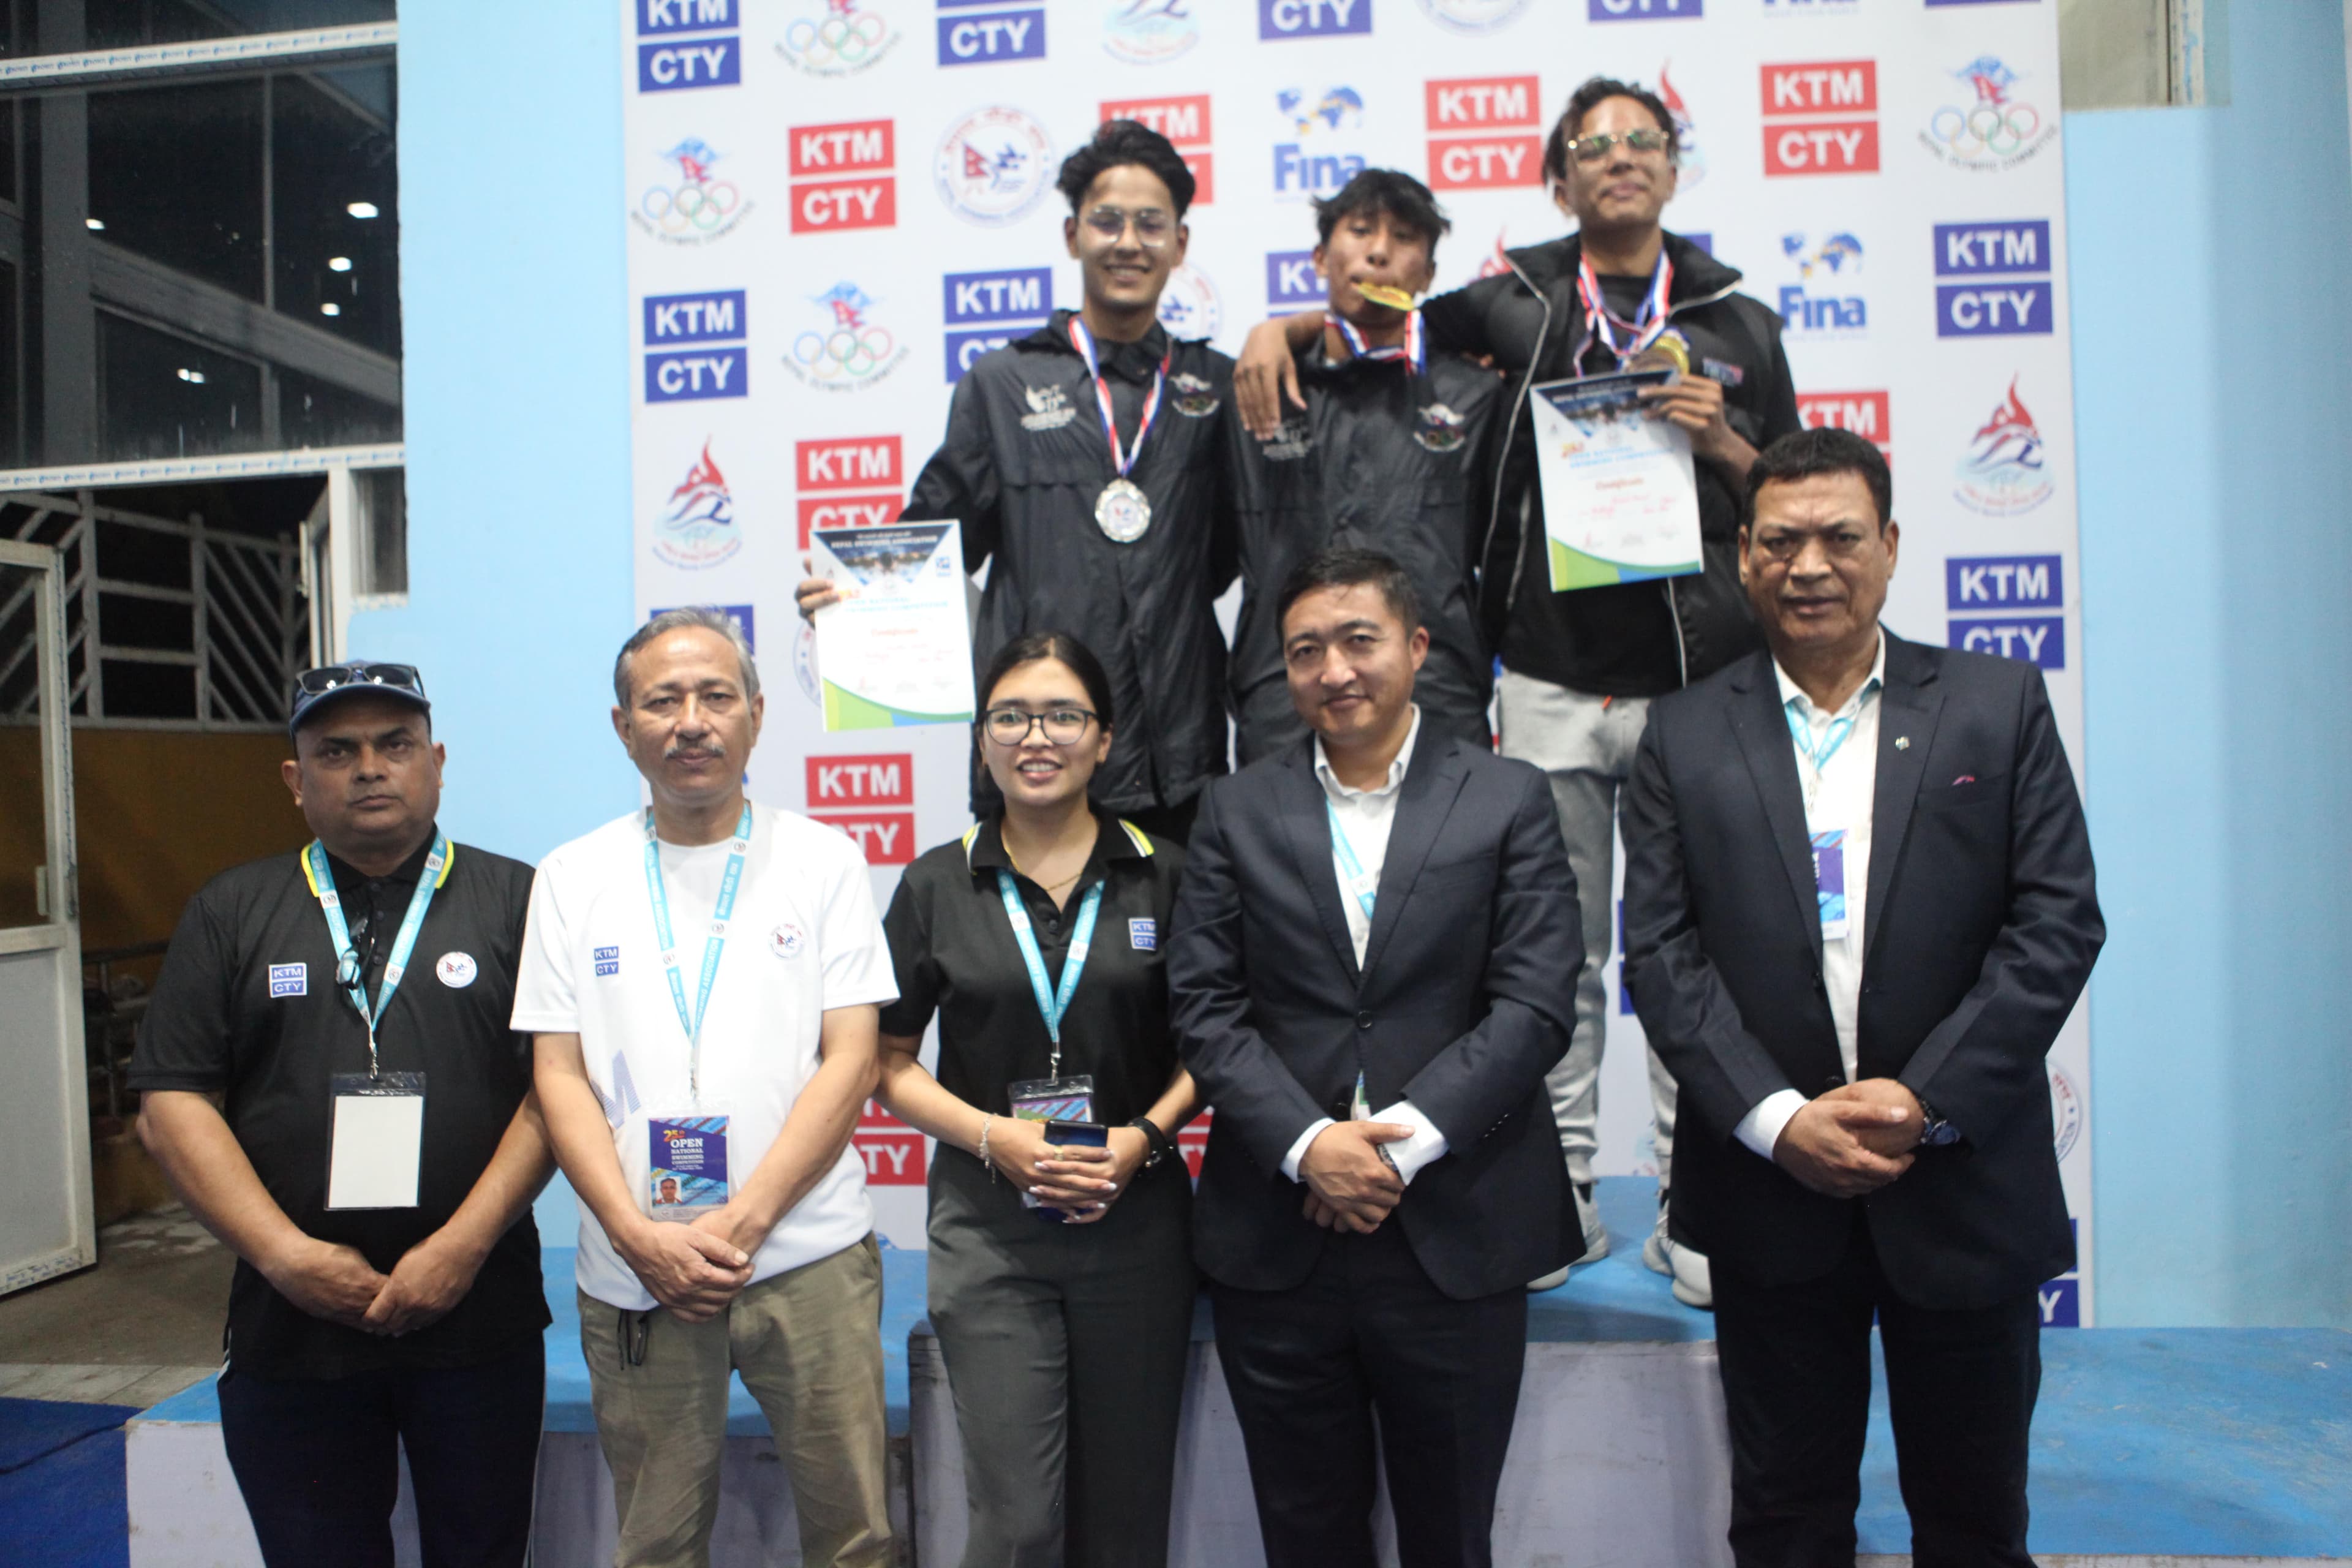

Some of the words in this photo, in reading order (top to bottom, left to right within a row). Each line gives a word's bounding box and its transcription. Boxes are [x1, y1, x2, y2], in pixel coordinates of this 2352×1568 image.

[647, 0, 727, 26] KTM
[1272, 0, 1354, 30] CTY
[951, 18, 1030, 56] CTY
[650, 45, 726, 83] CTY
[1438, 85, 1528, 122] KTM
[1774, 69, 1864, 107] KTM
[801, 129, 883, 167] KTM
[1442, 144, 1526, 182] CTY
[1777, 130, 1863, 167] CTY
[1274, 143, 1365, 190] Fina
[803, 186, 882, 224] CTY
[1948, 230, 2037, 266] KTM
[956, 277, 1041, 315] KTM
[1779, 285, 1866, 329] Fina
[1951, 290, 2036, 328] CTY
[655, 300, 734, 336] KTM
[657, 356, 733, 393] CTY
[808, 445, 891, 481] KTM
[1961, 565, 2049, 601] KTM
[1964, 627, 2048, 662] CTY
[818, 764, 900, 797] KTM
[595, 949, 617, 959] KTM
[597, 963, 617, 974] CTY
[274, 968, 301, 978] KTM
[274, 982, 301, 992] CTY
[670, 1137, 704, 1148] OPEN
[860, 1144, 910, 1175] TY
